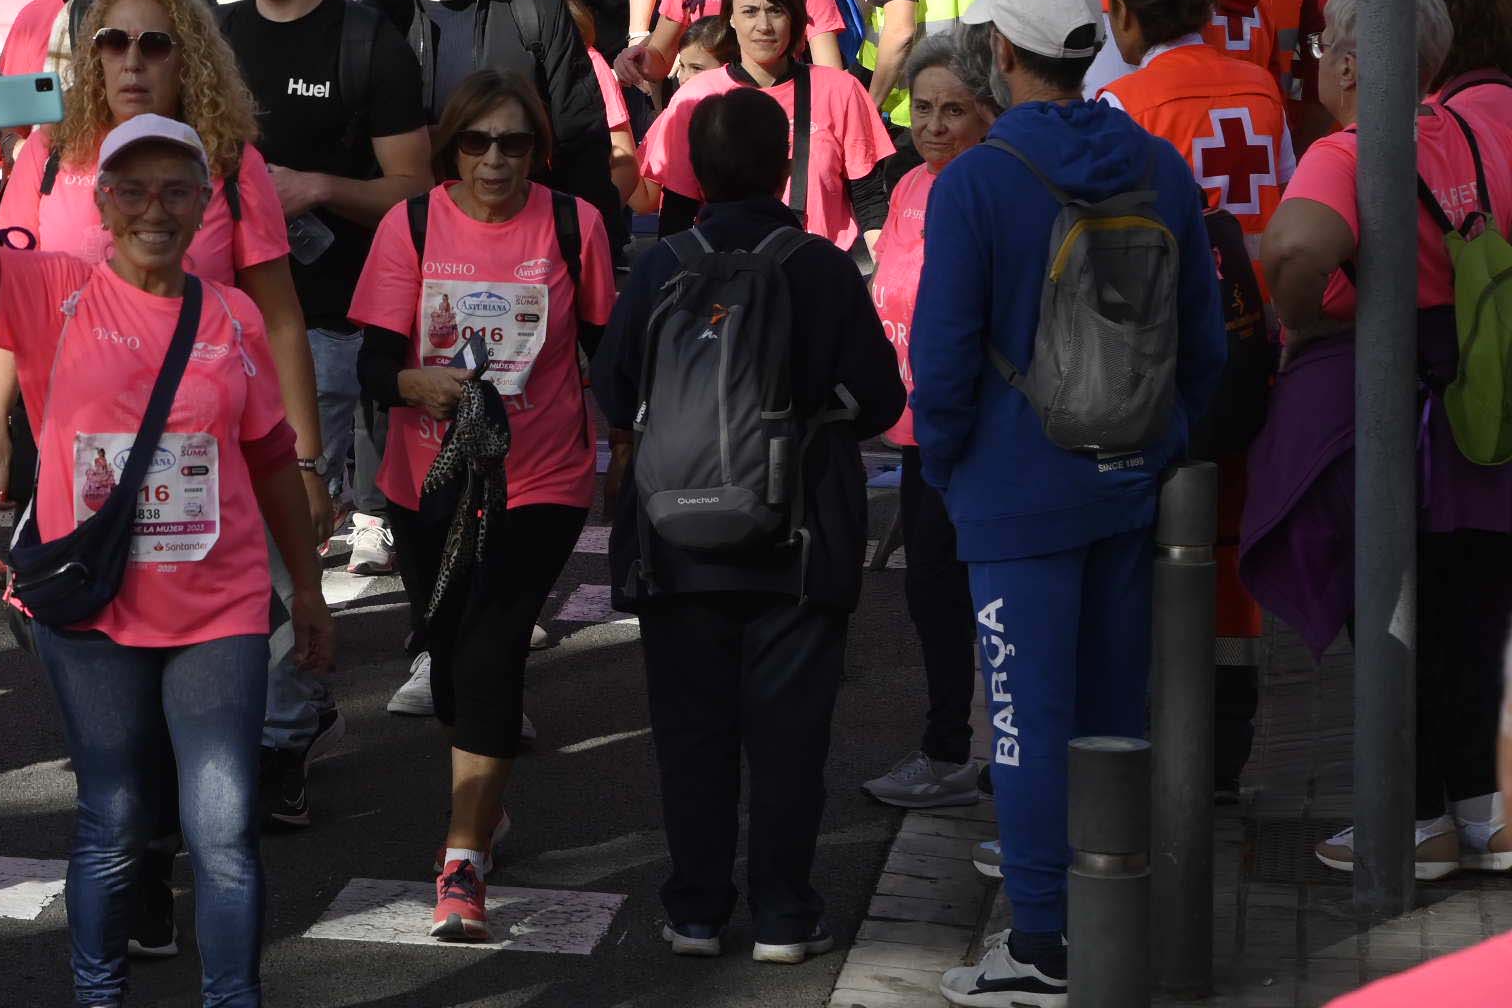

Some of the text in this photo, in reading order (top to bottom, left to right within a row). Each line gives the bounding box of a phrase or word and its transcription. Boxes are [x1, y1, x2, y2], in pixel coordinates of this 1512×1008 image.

[287, 78, 330, 98] Huel
[423, 261, 475, 276] OYSHO
[462, 299, 507, 313] ASTURIANA
[1097, 461, 1125, 473] SINCE
[677, 496, 720, 506] Quechua
[155, 524, 185, 533] MUJER
[164, 542, 207, 553] Santander
[977, 597, 1021, 767] BARÇA
